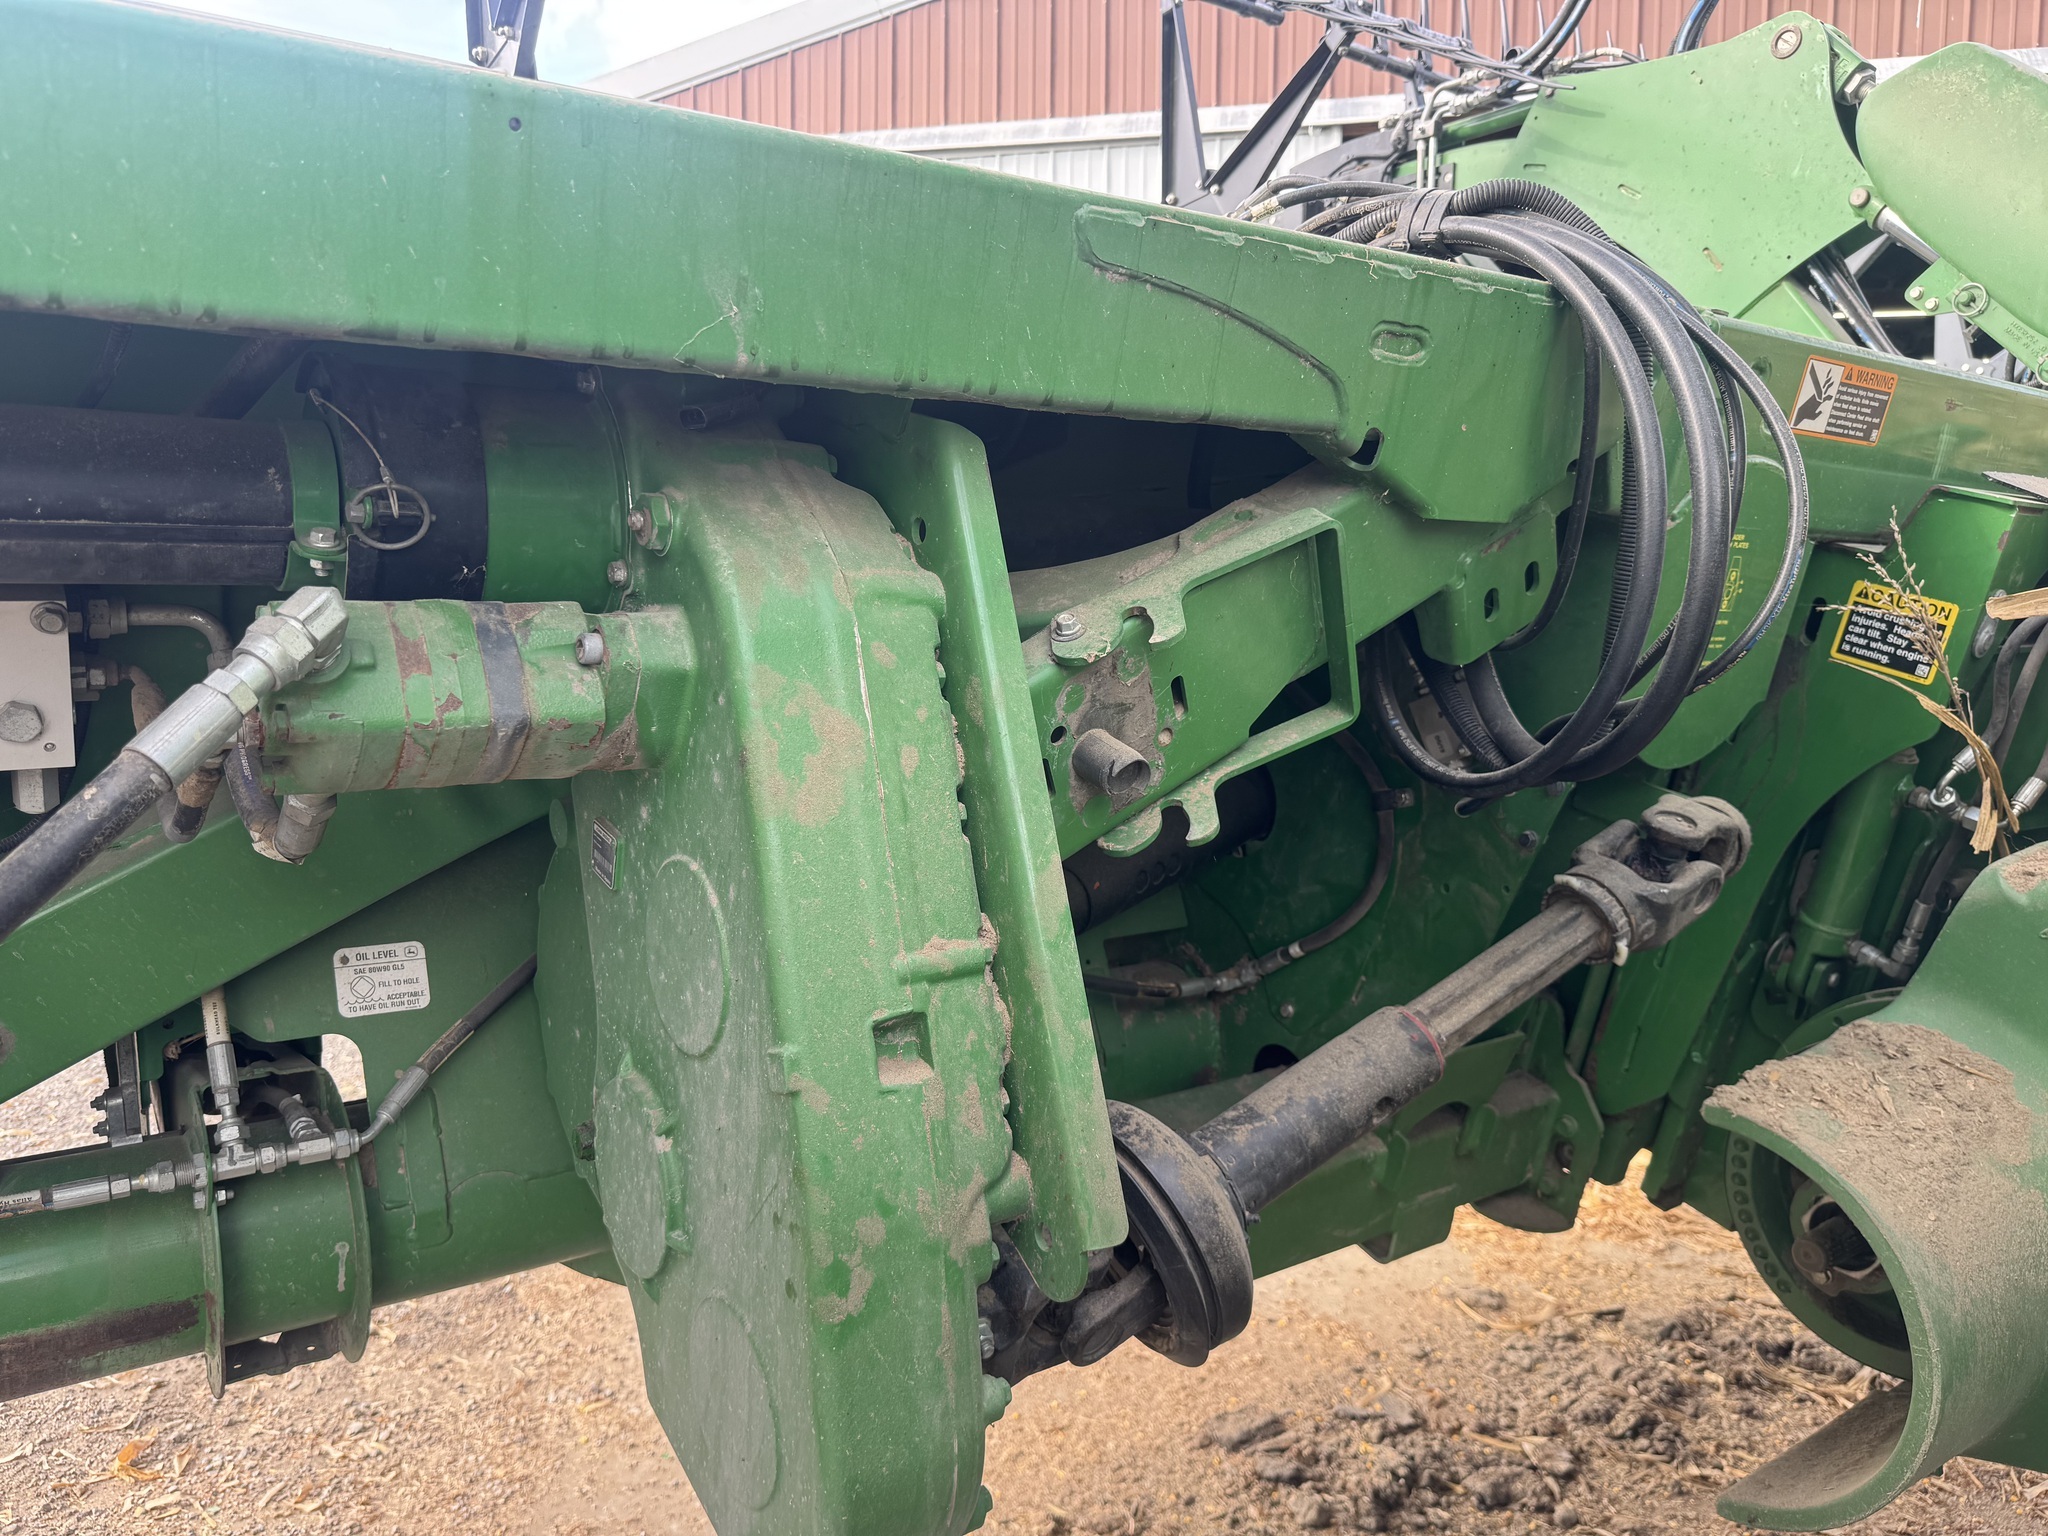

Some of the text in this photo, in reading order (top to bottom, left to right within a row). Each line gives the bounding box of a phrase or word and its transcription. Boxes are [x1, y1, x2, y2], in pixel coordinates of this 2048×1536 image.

[1856, 369, 1895, 390] WARNING
[1871, 589, 1952, 621] CAUTON
[1851, 613, 1888, 631] injuries.
[1844, 633, 1869, 646] clear
[1870, 640, 1895, 654] when
[1848, 624, 1909, 648] can tilt. Stay
[1841, 641, 1890, 664] is running.
[355, 949, 399, 961] OIL LEVEL
[368, 966, 391, 974] 80W90
[392, 963, 405, 971] GL5
[378, 980, 391, 988] FILL
[403, 977, 420, 985] HOLE
[360, 1003, 377, 1011] HAVE
[391, 1000, 405, 1008] RUN
[406, 998, 420, 1006] OUT
[386, 990, 425, 1001] ACCEPTABLE
